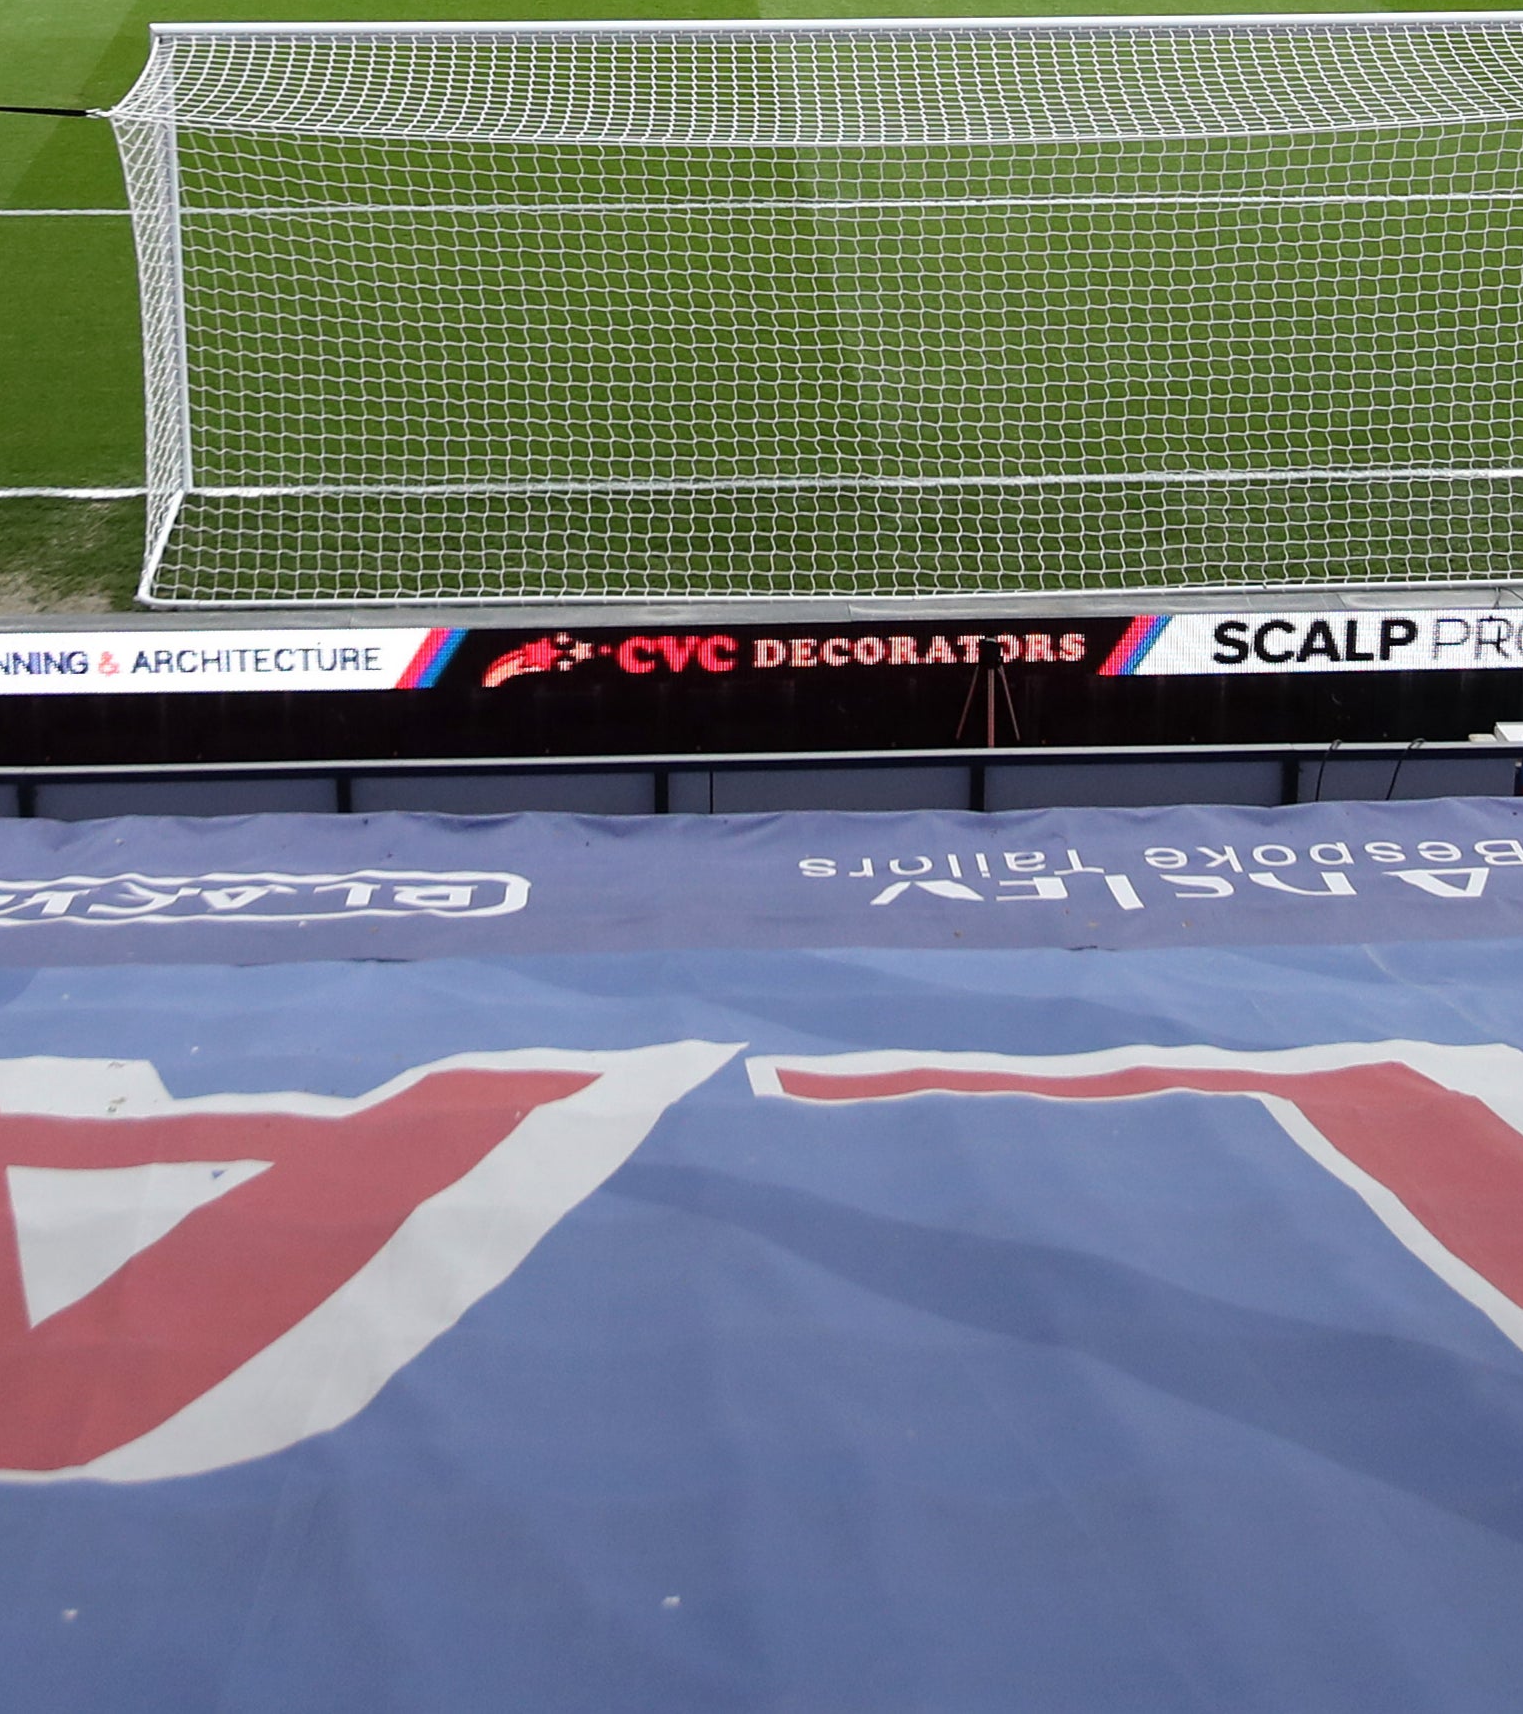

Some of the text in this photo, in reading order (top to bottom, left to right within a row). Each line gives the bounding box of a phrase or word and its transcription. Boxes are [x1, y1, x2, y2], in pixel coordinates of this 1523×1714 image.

[130, 641, 384, 675] ARCHITECTURE
[618, 632, 1088, 674] CVC DECORATORS
[1212, 618, 1418, 664] SCALP
